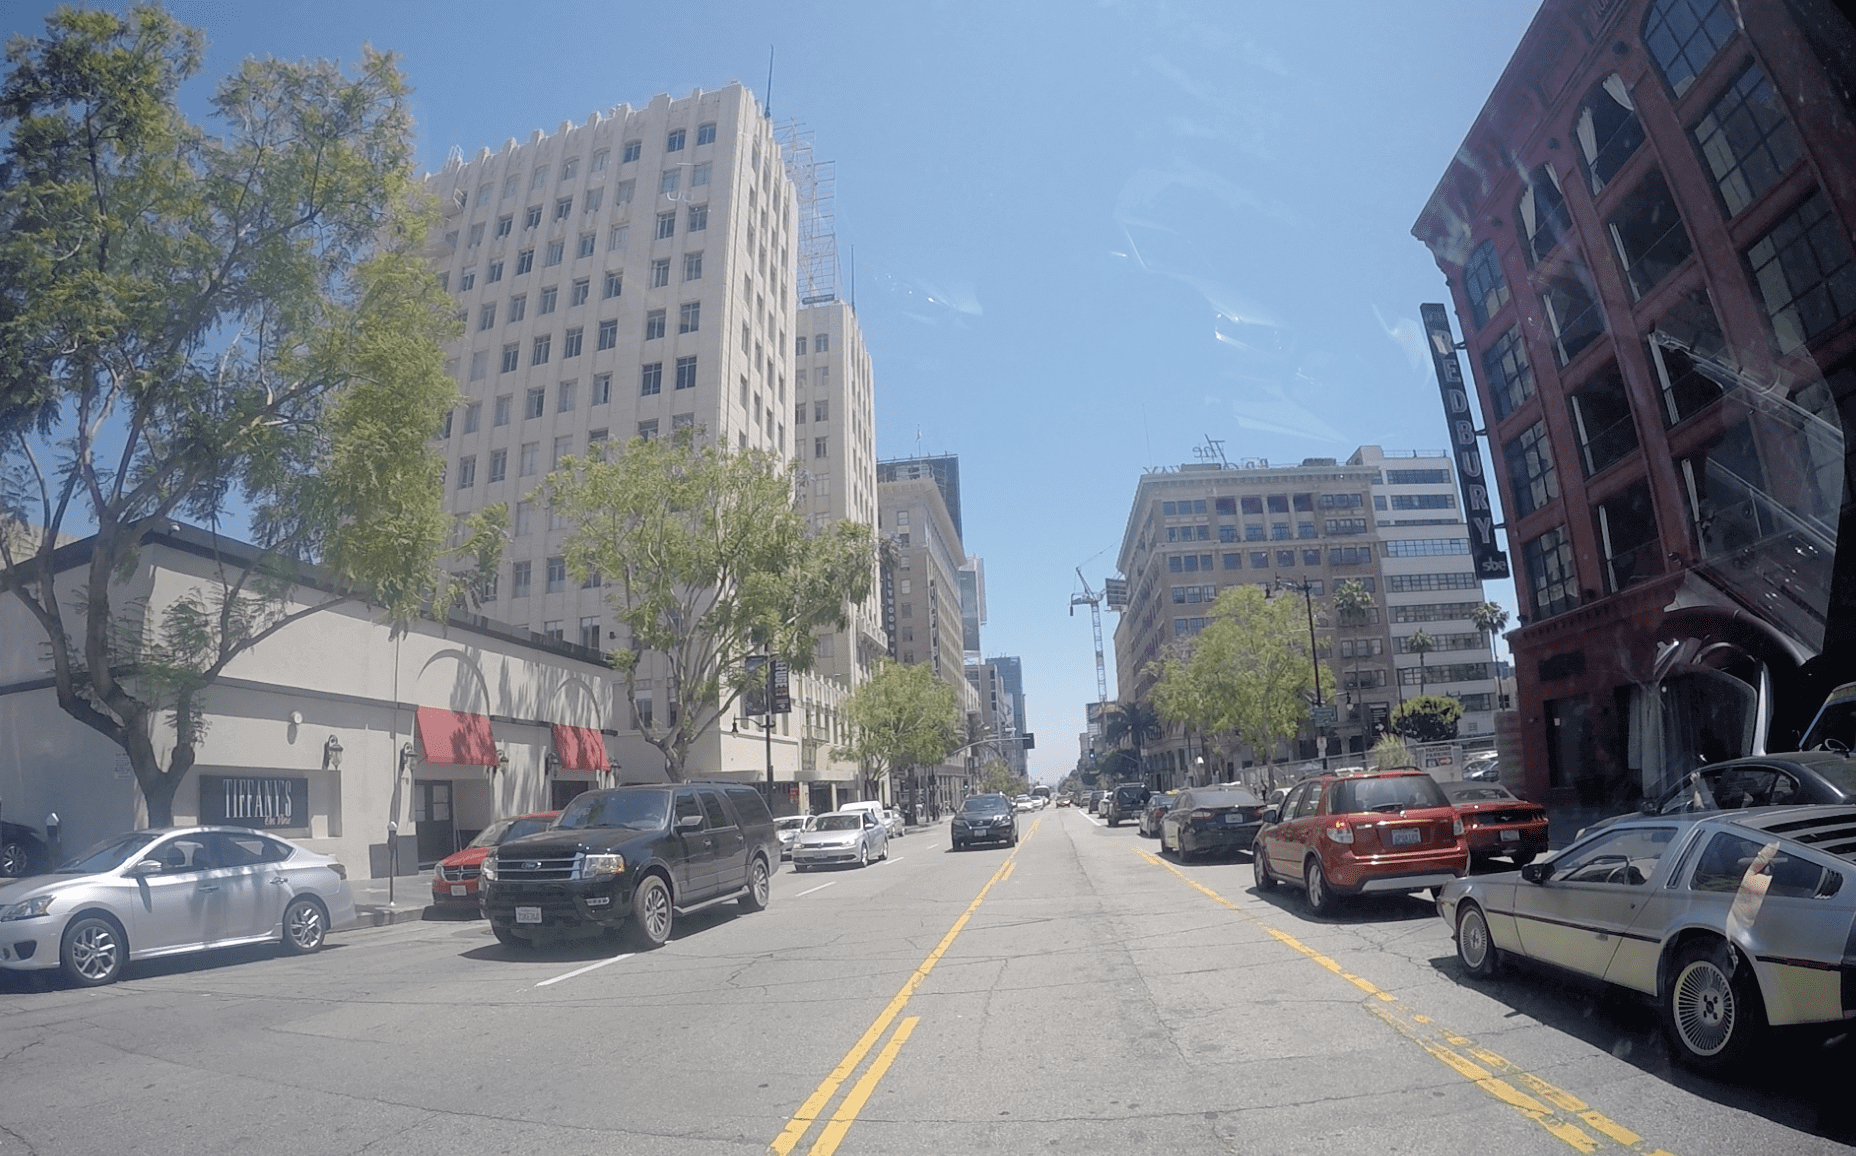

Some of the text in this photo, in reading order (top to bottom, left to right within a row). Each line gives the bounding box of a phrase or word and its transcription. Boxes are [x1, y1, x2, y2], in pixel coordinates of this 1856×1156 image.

[1431, 329, 1489, 544] REDBURY
[1482, 556, 1507, 572] sbe
[223, 778, 292, 818] TIFFANY'S
